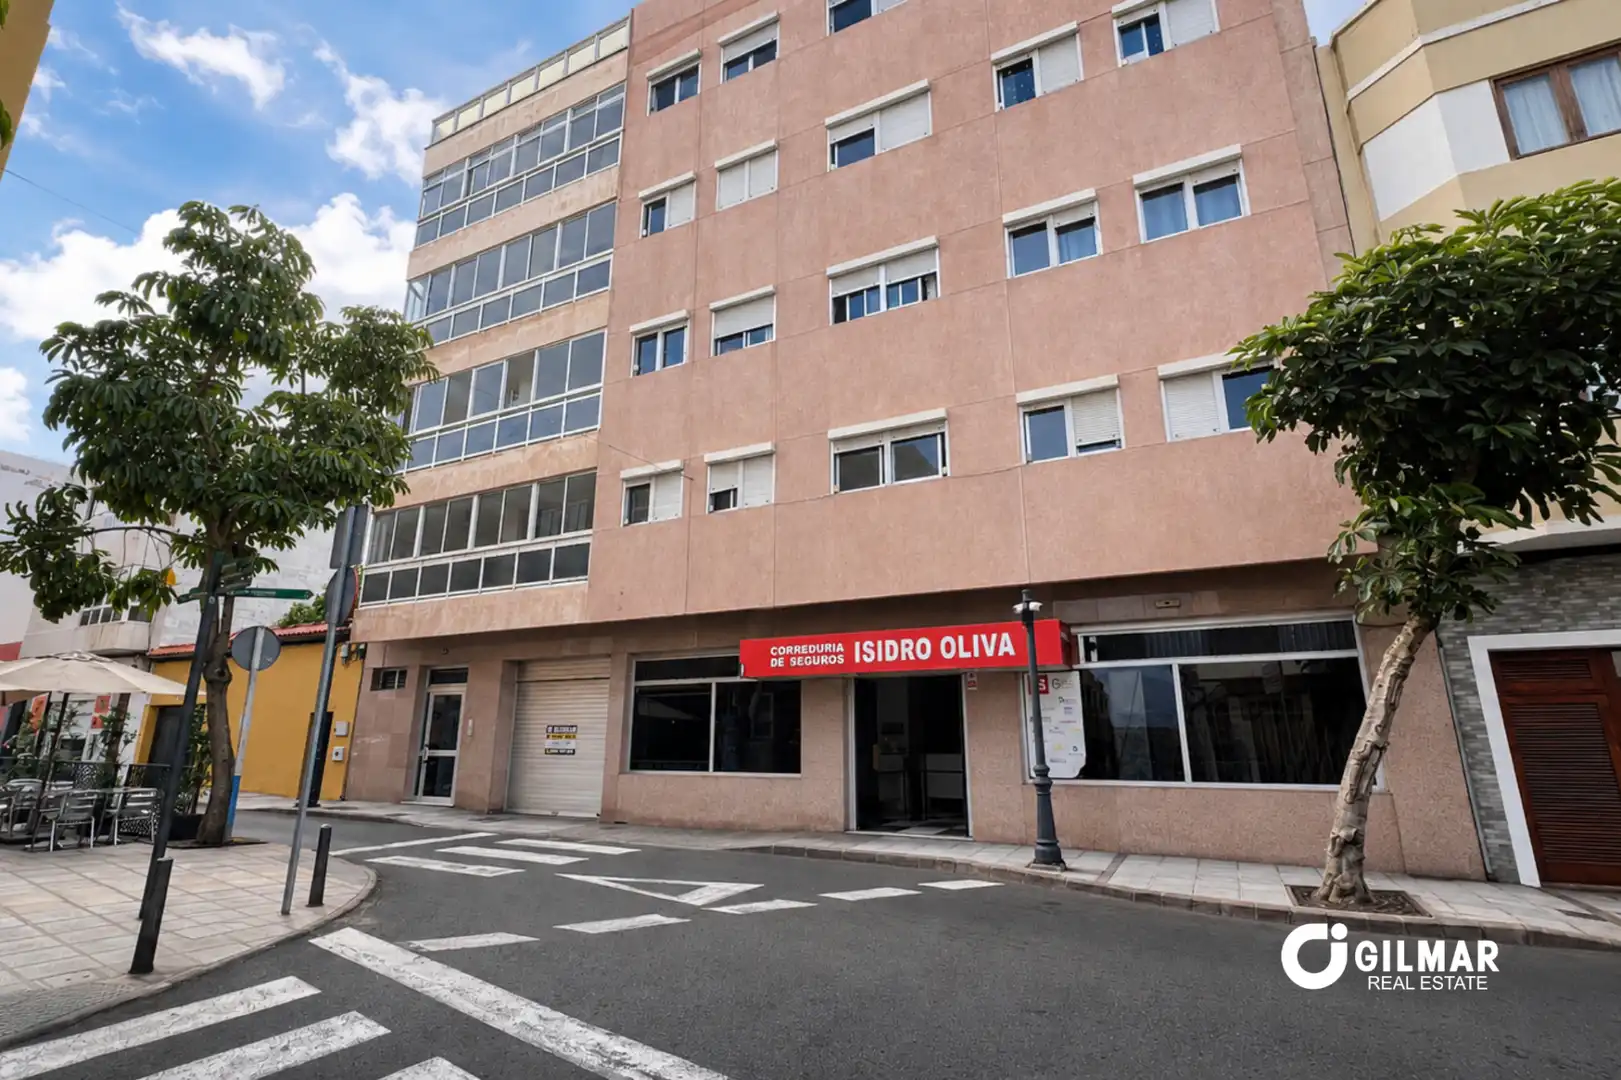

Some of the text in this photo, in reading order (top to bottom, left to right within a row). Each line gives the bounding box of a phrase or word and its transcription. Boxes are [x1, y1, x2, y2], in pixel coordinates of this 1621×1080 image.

[770, 643, 844, 656] CORREDURIA
[854, 632, 1016, 664] ISIDRO OLIVA
[770, 654, 845, 668] DE SEGUROS
